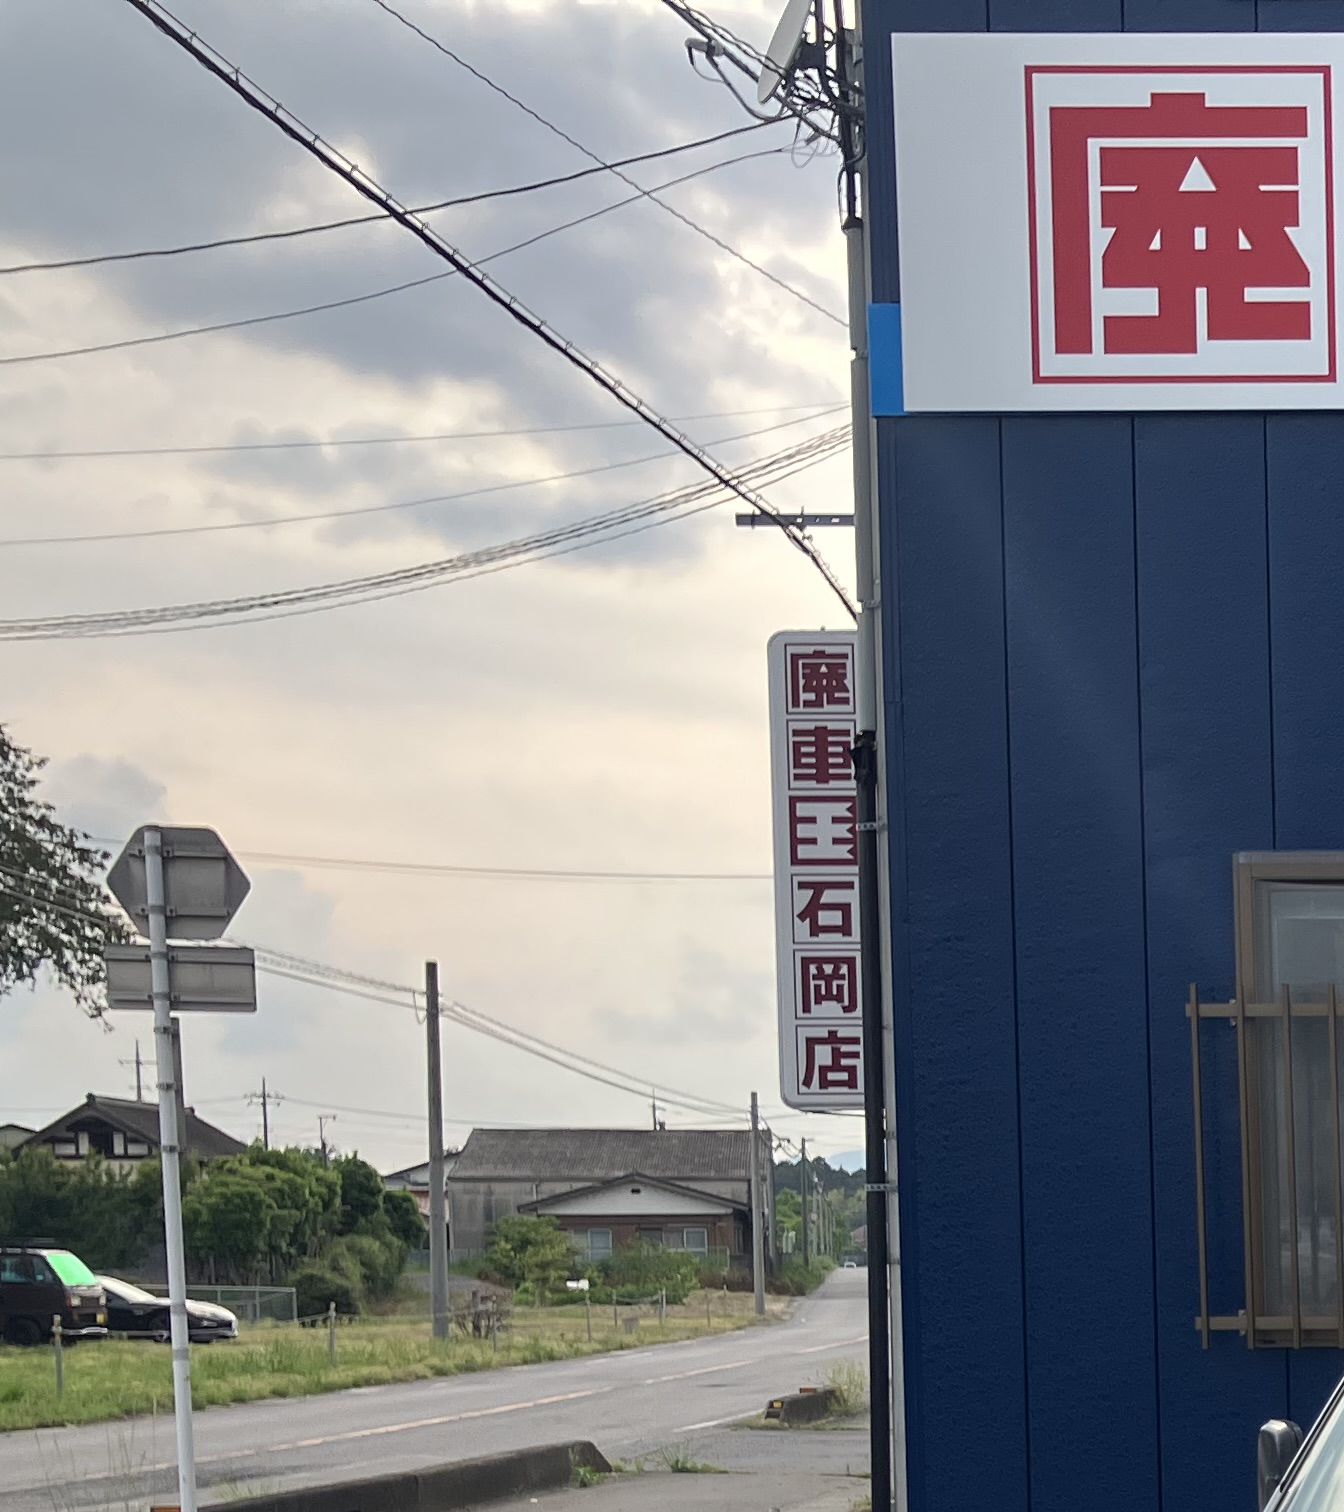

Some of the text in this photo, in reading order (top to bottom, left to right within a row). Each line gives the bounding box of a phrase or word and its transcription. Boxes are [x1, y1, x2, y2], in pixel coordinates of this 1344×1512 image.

[789, 649, 862, 1091] 廃車王石岡店
